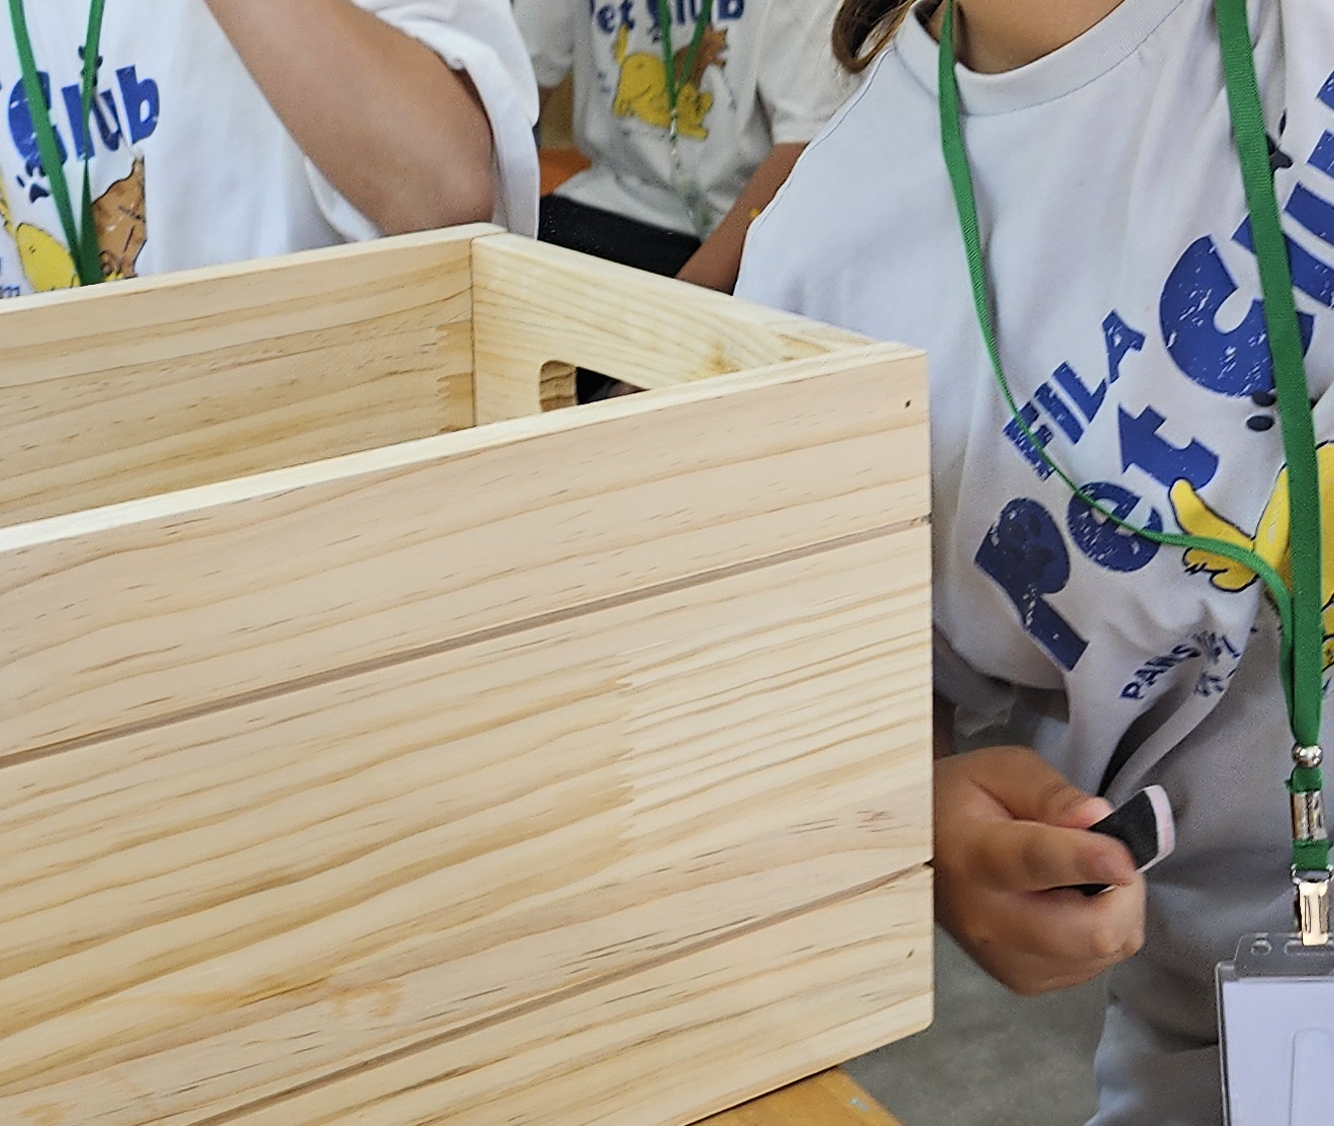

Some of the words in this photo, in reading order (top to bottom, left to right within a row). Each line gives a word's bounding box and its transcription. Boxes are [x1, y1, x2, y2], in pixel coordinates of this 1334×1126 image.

[8, 64, 160, 172] Club
[1001, 310, 1146, 480] FILA
[974, 404, 1220, 672] Pet
